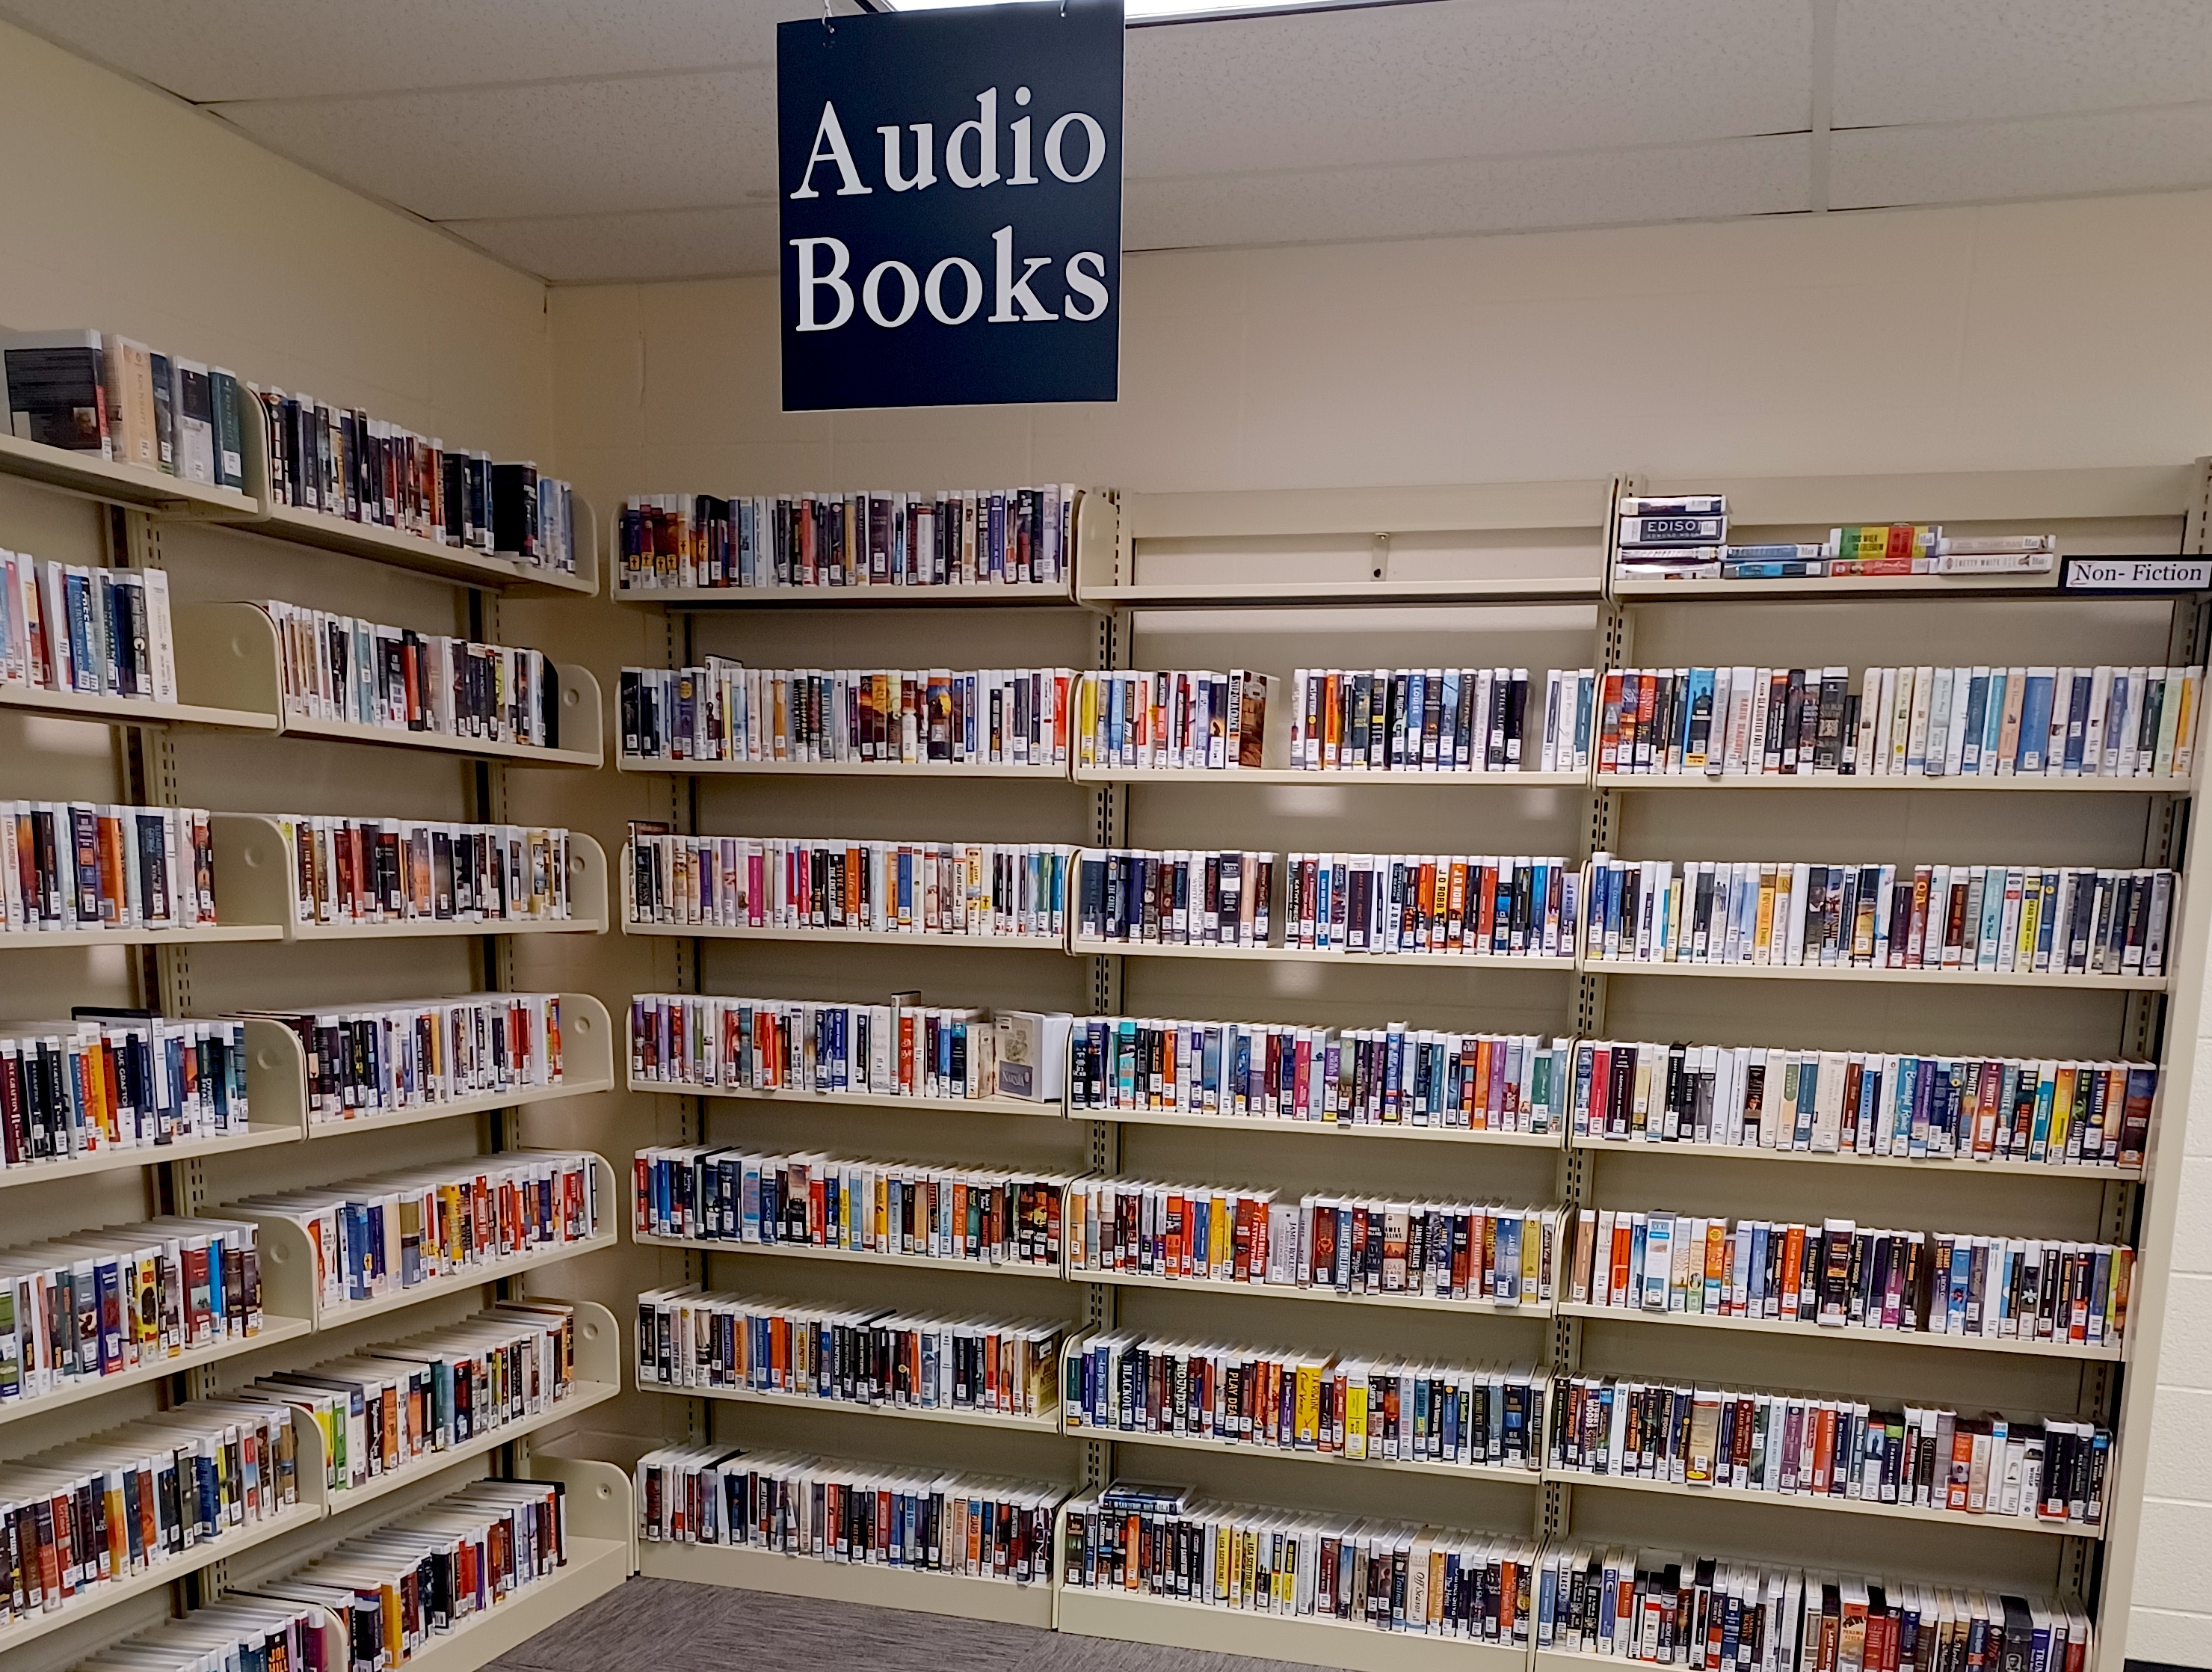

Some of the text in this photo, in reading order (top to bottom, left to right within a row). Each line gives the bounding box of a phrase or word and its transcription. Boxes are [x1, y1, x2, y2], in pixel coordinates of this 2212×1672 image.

[789, 87, 1106, 199] Audio
[789, 225, 1109, 332] Books
[2076, 563, 2202, 581] Non- Fiction
[1715, 706, 1725, 735] SLAUGHTER
[1738, 698, 1748, 720] KARIN
[1754, 698, 1765, 734] SLAUGHTER
[145, 828, 155, 853] GEORGE
[7, 838, 16, 870] GARDNER
[836, 864, 844, 888] STEVE
[848, 872, 856, 901] Life of
[1436, 887, 1445, 908] ROBB
[1452, 887, 1462, 909] ROBB
[117, 1049, 129, 1107] SUE GRAFTO
[1903, 1070, 1914, 1106] Beautiful
[1966, 1071, 1978, 1095] WHITE
[9, 1078, 19, 1112] GRAFTON
[1985, 1083, 1995, 1107] WHITE
[2002, 1085, 2012, 1108] WHITE
[2038, 1101, 2048, 1120] WHITE
[1257, 1223, 1266, 1241] JAMES
[1287, 1222, 1296, 1278] JAMES ROLLINS
[1339, 1223, 1351, 1272] JAMES ROLLIN
[1411, 1225, 1422, 1268] JAMES ROLLINS
[1506, 1235, 1515, 1255] JAMES
[1674, 1247, 1682, 1271] WIGGS
[1775, 1259, 1783, 1279] WOODS
[1808, 1249, 1817, 1271] STUART
[1852, 1241, 1862, 1284] STUART WOODS
[1121, 1364, 1133, 1410] BLACKOU
[1175, 1364, 1189, 1414] HOUNDED
[1227, 1372, 1239, 1416] PLAY DEA
[1310, 1386, 1318, 1412] ROWLING
[1586, 1400, 1595, 1427] WOODS
[1568, 1415, 1576, 1437] WOODS
[1661, 1417, 1669, 1437] WOODS
[1414, 1572, 1425, 1586] Off
[1476, 1572, 1484, 1589] Daniel
[1561, 1572, 1569, 1592] BLACK
[1444, 1590, 1452, 1607] Heist
[268, 1659, 289, 1672] HILL
[269, 1645, 286, 1663] JOE
